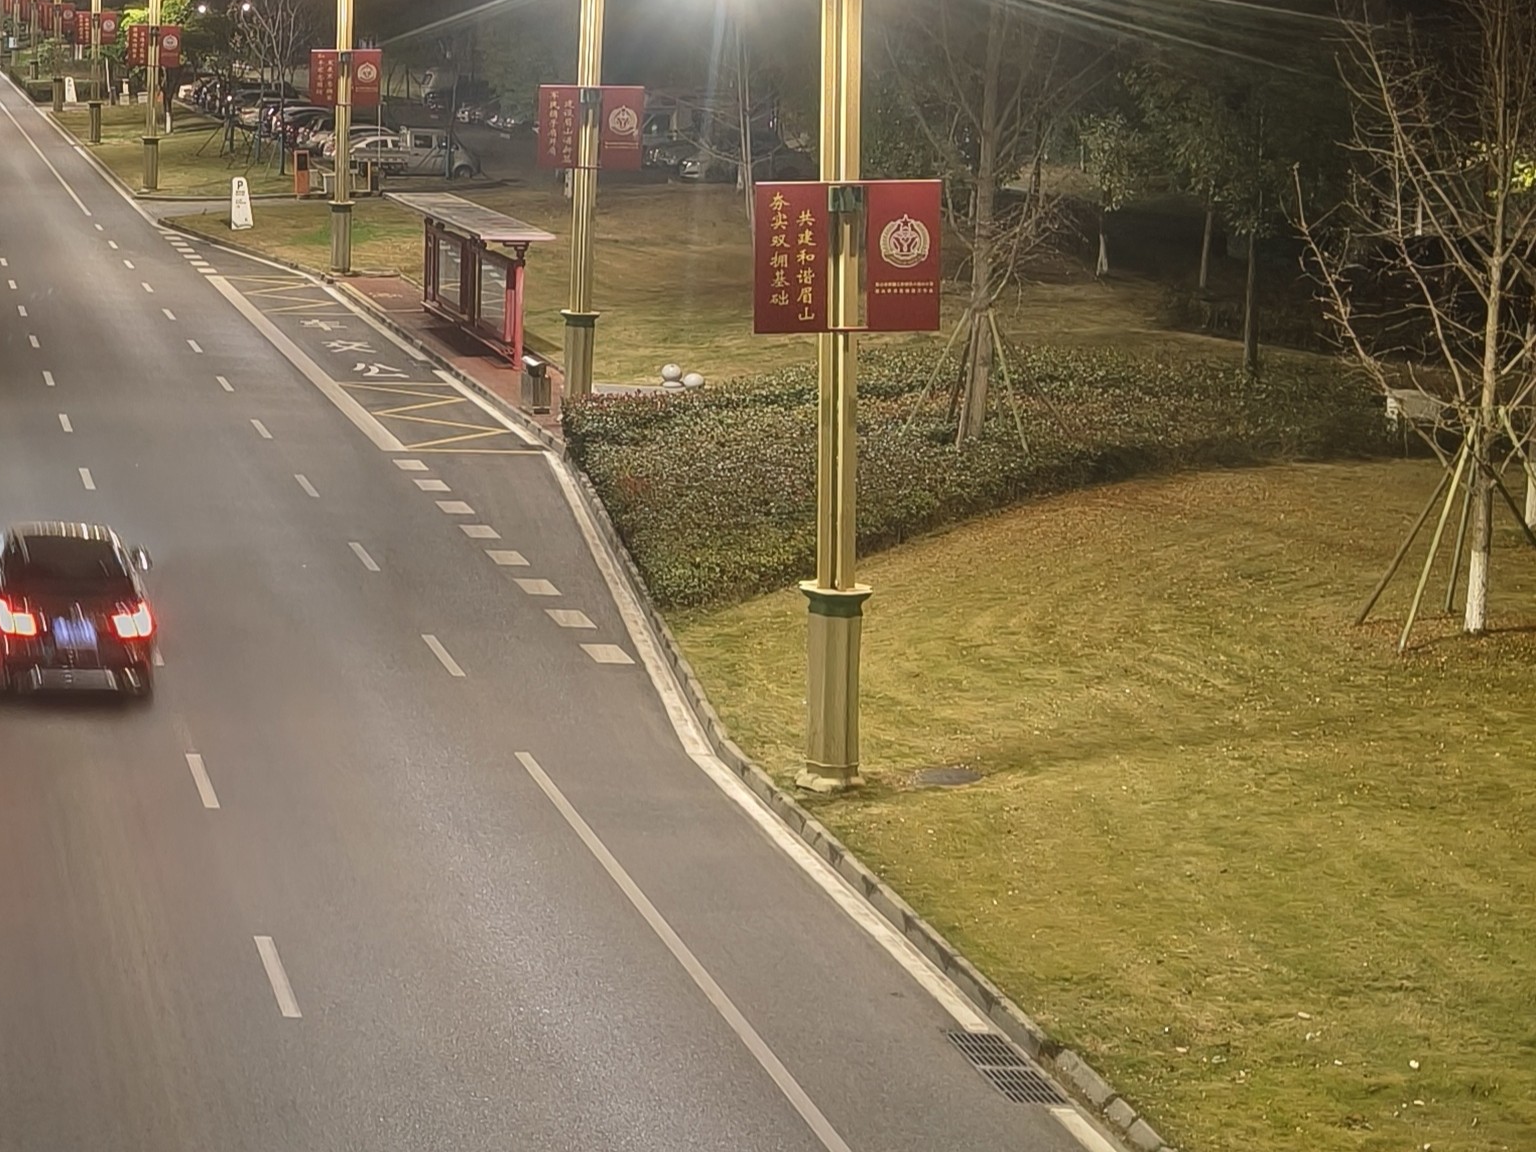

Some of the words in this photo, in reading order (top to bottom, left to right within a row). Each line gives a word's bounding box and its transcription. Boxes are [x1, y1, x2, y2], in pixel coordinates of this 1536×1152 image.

[237, 180, 244, 190] P
[769, 192, 790, 306] 夯实双拥基础
[796, 209, 816, 321] 共建和谐眉山
